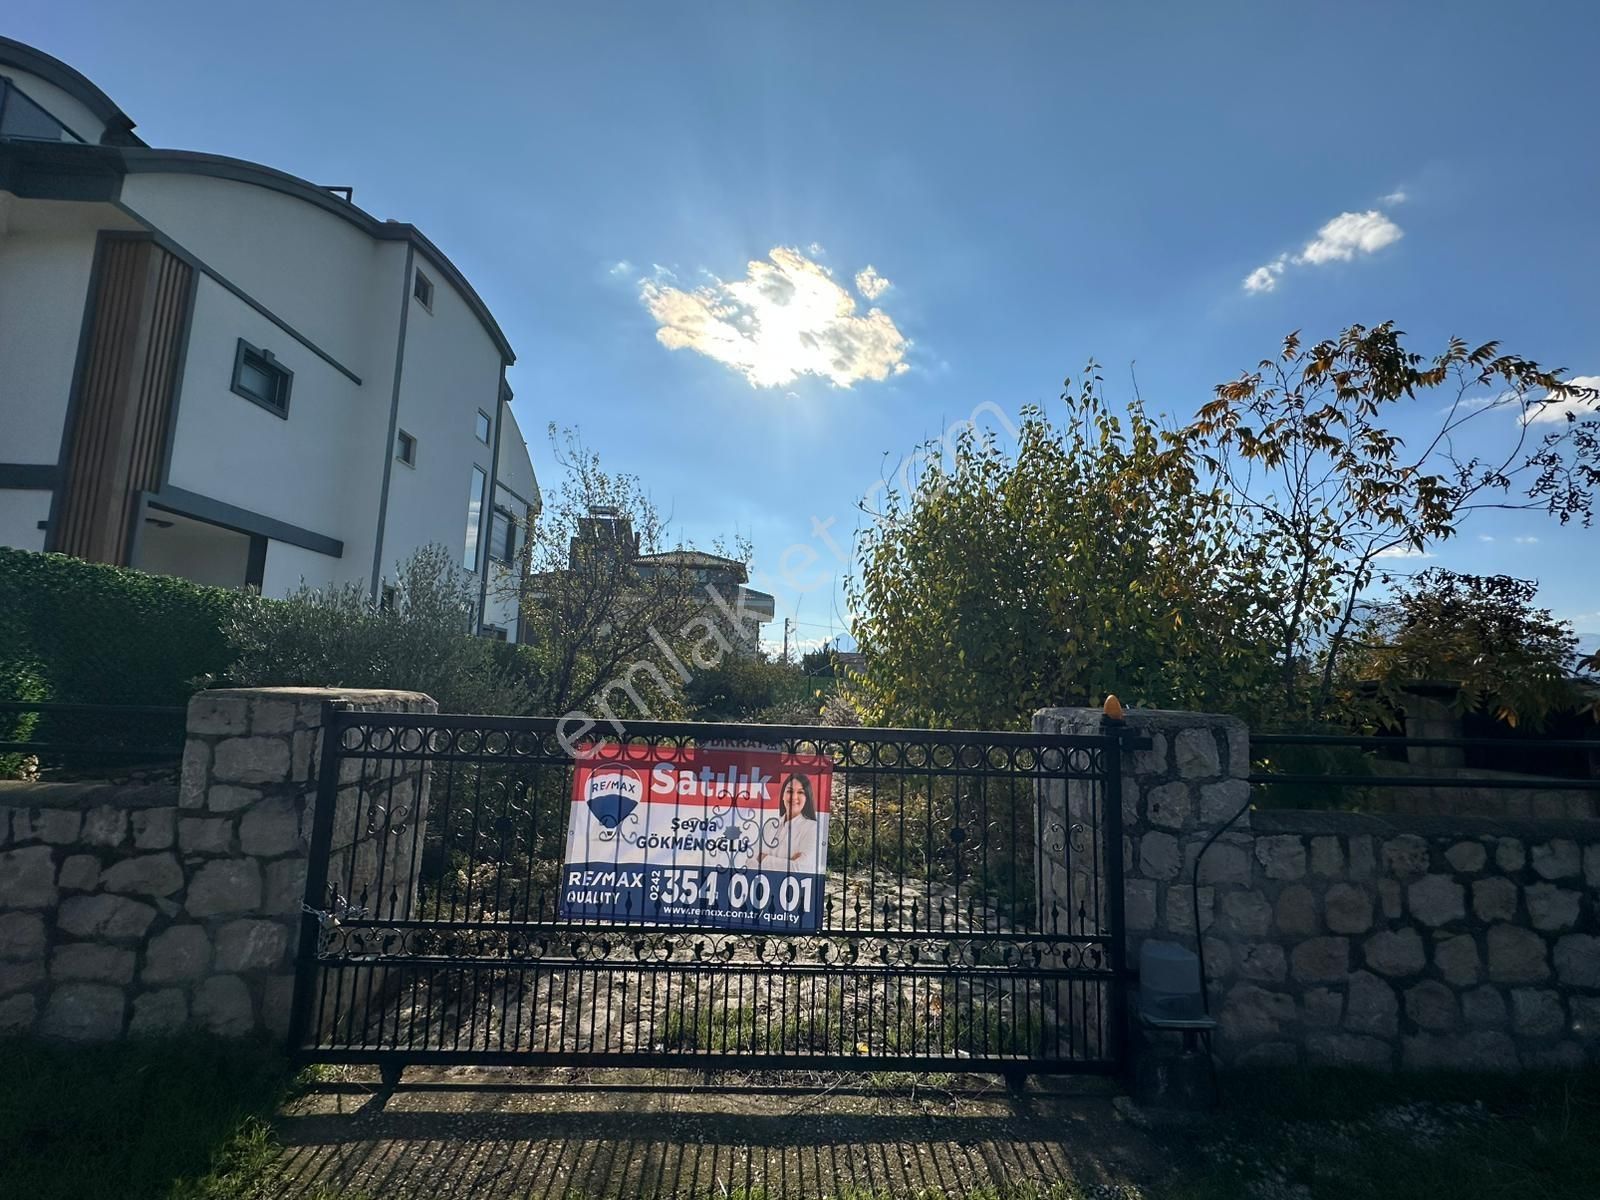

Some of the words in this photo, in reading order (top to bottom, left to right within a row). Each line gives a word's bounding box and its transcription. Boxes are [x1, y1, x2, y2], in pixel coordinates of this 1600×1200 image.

[591, 780, 636, 794] RE/MAX
[651, 762, 771, 800] Satılık
[671, 818, 718, 833] Şeyda
[636, 834, 749, 852] GÖKMENOĞLU
[568, 872, 643, 888] RE/MAX
[649, 870, 661, 901] 0242
[566, 890, 620, 904] QUALITY
[661, 869, 718, 906] 354
[728, 873, 770, 910] 00
[779, 876, 813, 912] 01
[663, 906, 799, 923] www.remax.com.tr/quality
